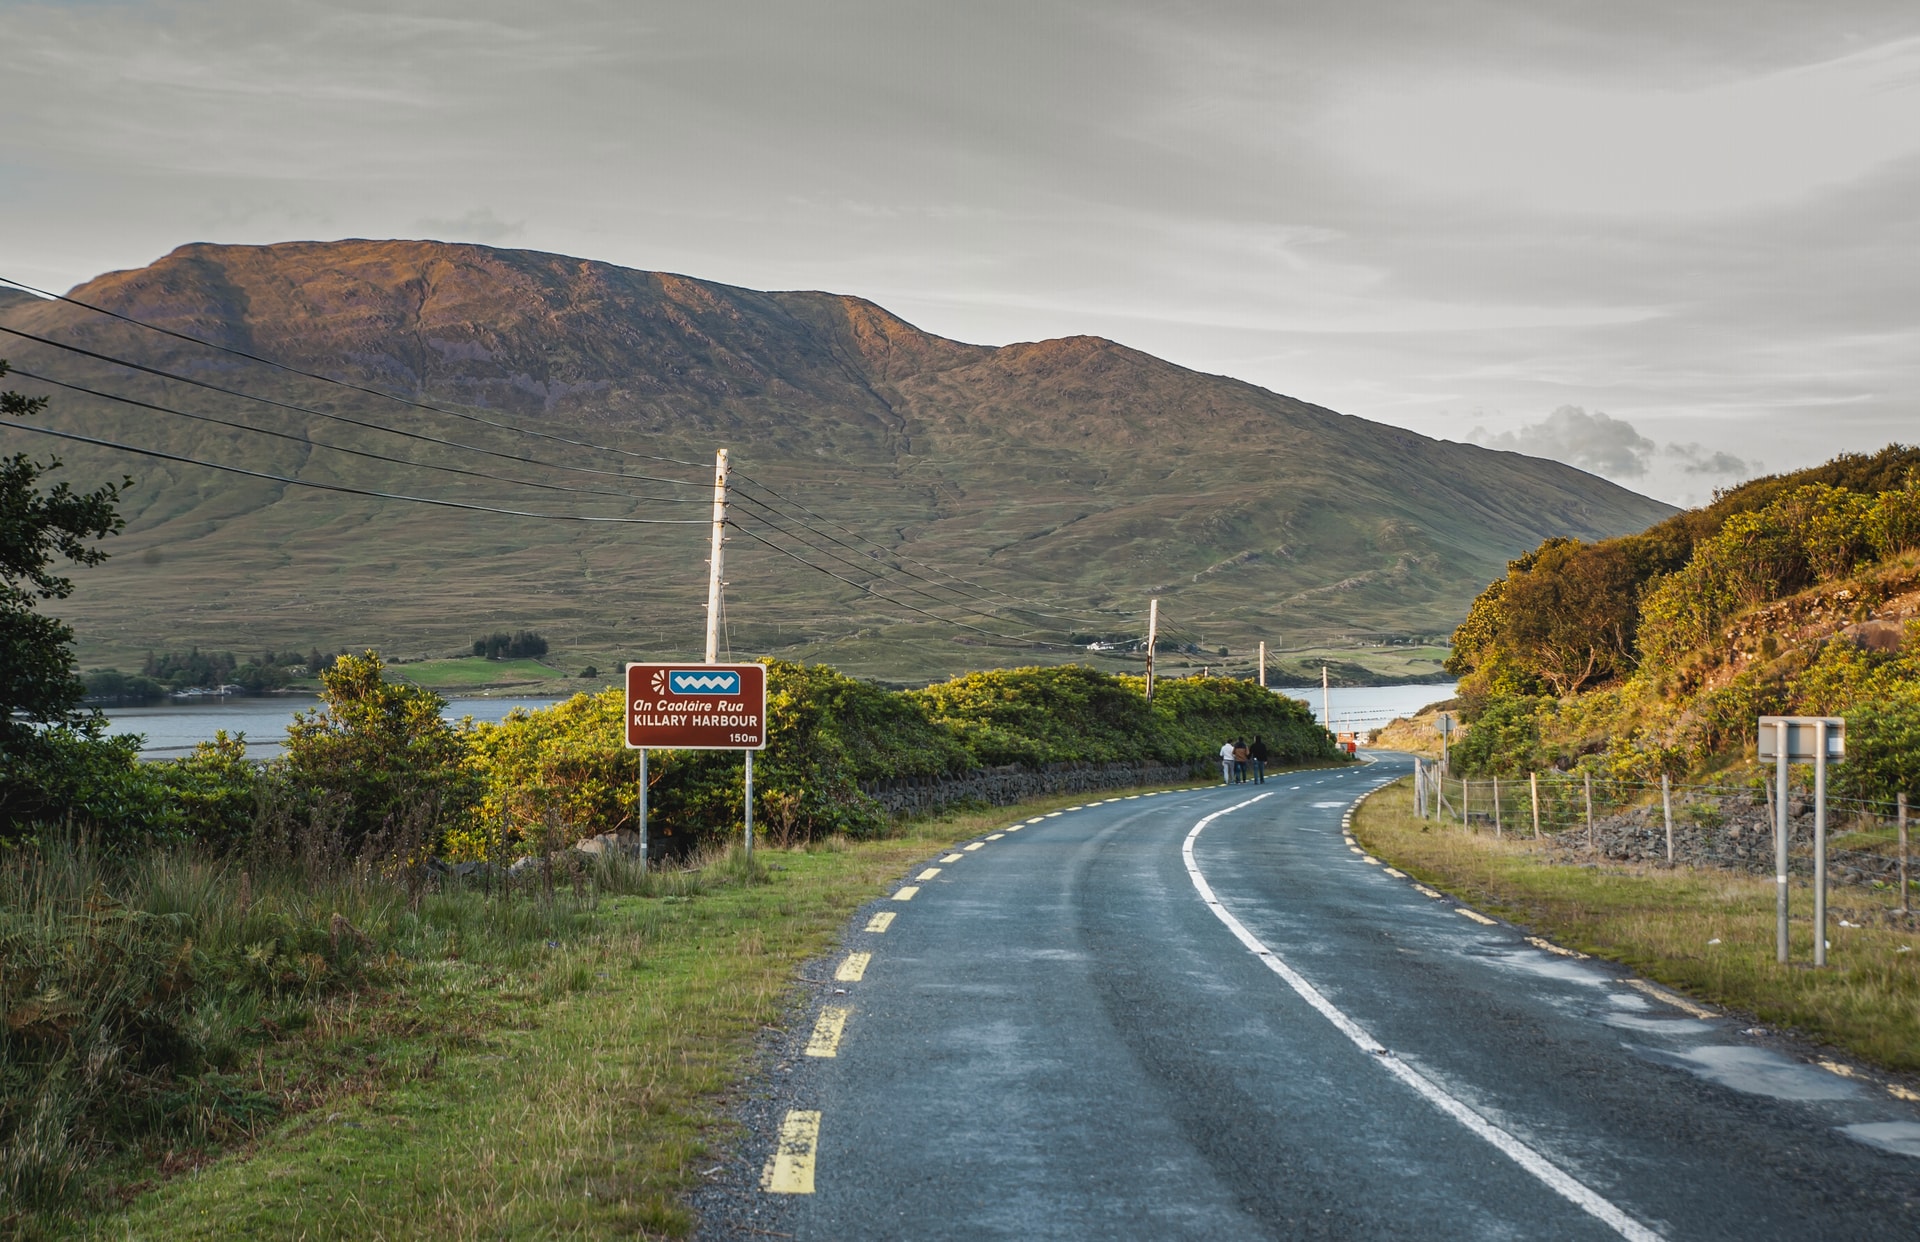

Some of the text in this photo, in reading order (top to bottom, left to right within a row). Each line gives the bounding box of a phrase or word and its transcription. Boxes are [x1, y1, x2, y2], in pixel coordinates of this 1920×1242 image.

[656, 699, 712, 712] Caoláire
[717, 700, 744, 712] Rua
[634, 714, 758, 727] KILLARY HARBOUR
[729, 733, 758, 743] 150m
